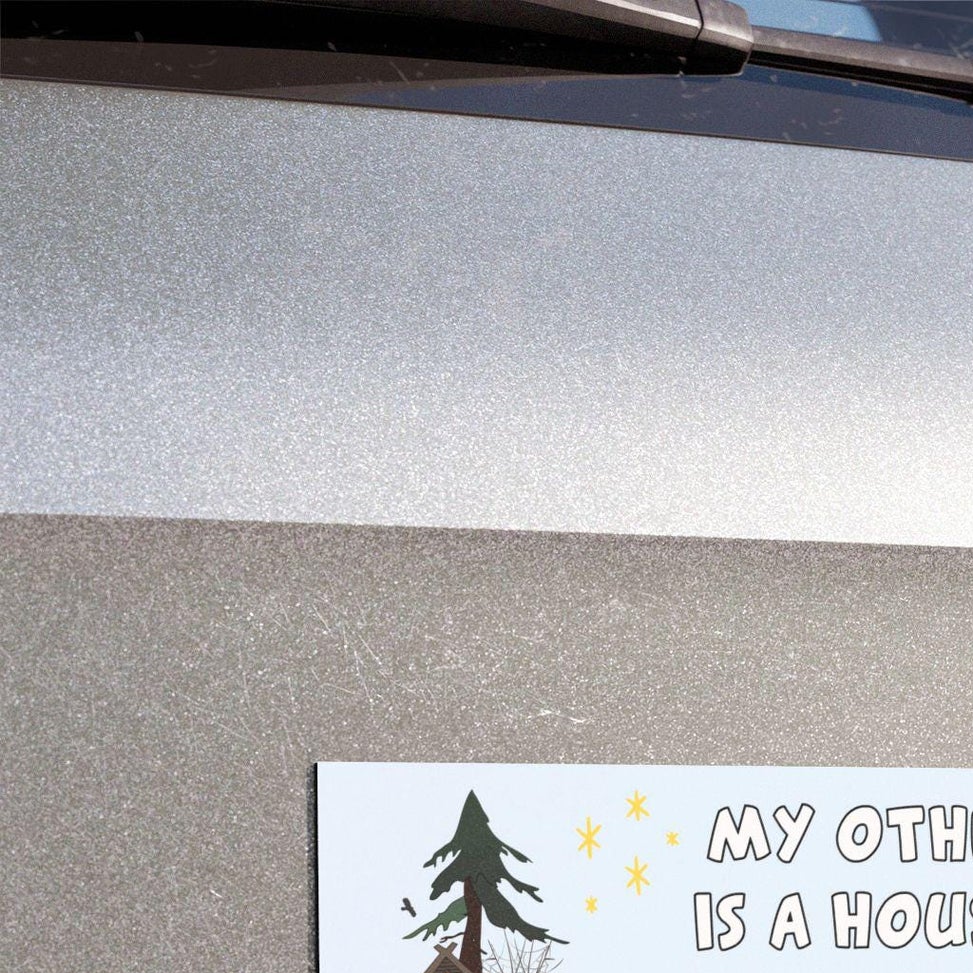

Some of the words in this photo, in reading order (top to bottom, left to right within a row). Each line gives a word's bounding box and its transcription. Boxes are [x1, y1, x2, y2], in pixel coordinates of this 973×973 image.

[706, 803, 816, 864] MY
[693, 891, 746, 952] IS
[768, 891, 812, 952] A
